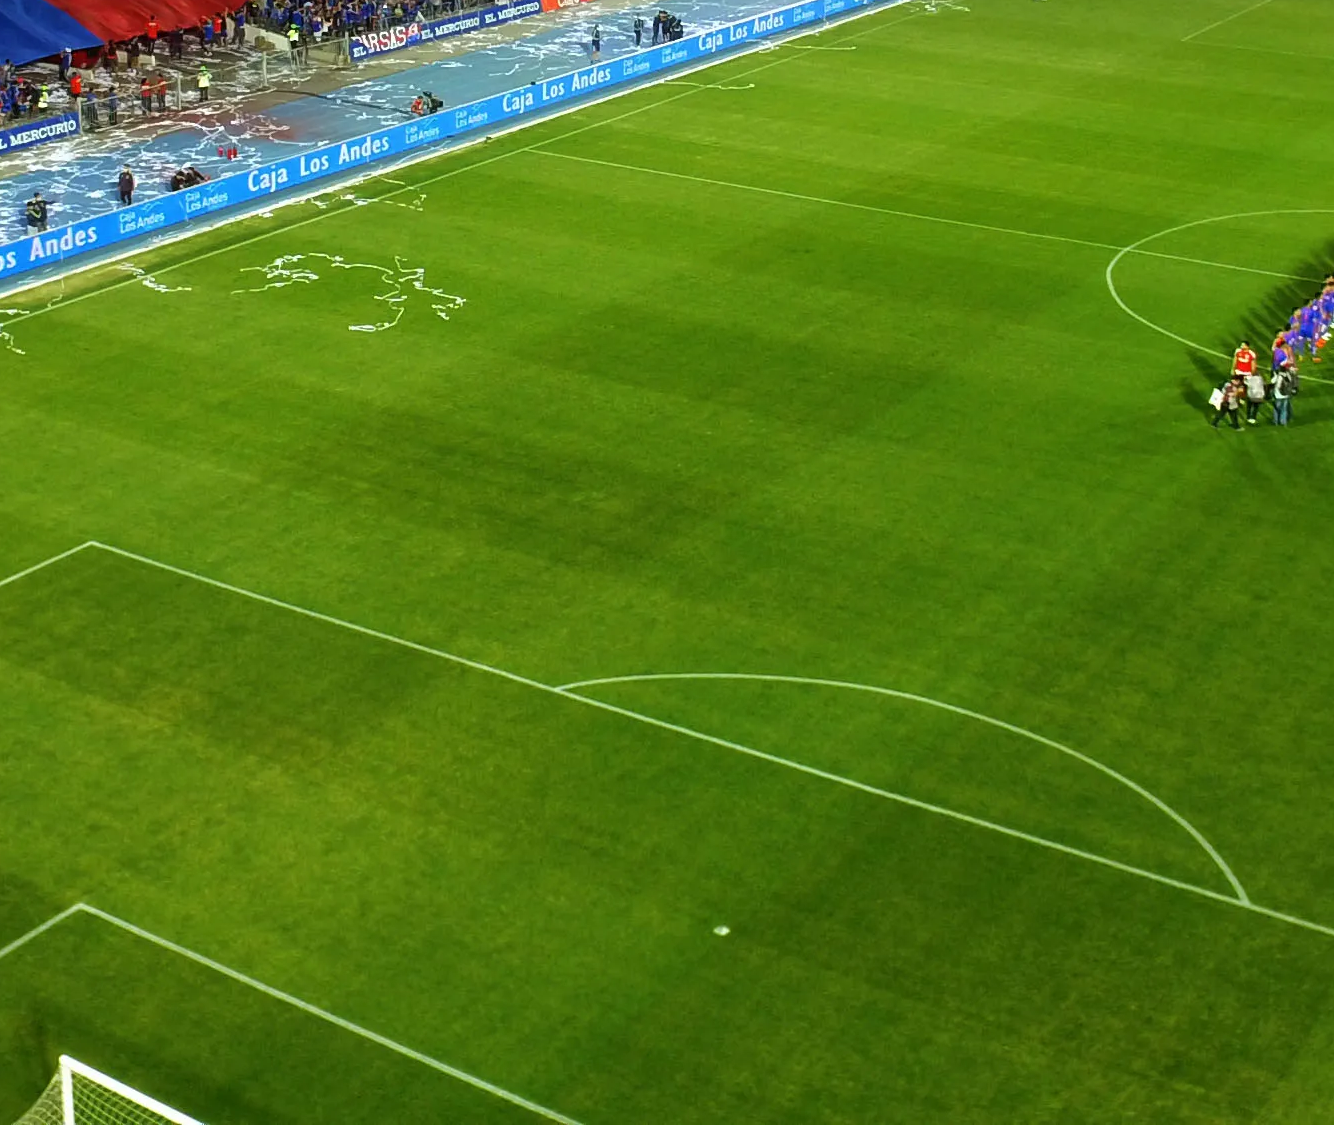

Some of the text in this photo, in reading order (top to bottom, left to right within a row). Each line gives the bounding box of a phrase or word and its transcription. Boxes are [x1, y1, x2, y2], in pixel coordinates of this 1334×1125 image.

[484, 2, 540, 24] EL MERCURIO
[421, 17, 480, 40] EL MERCURIO
[698, 15, 784, 53] Caja Los Andes
[353, 44, 367, 57] EL
[502, 67, 611, 114] Caja Los Andes
[10, 120, 76, 148] MERCURIO
[248, 135, 390, 193] Caja Los Andes
[120, 210, 165, 235] Los Andes
[29, 225, 98, 261] Andes
